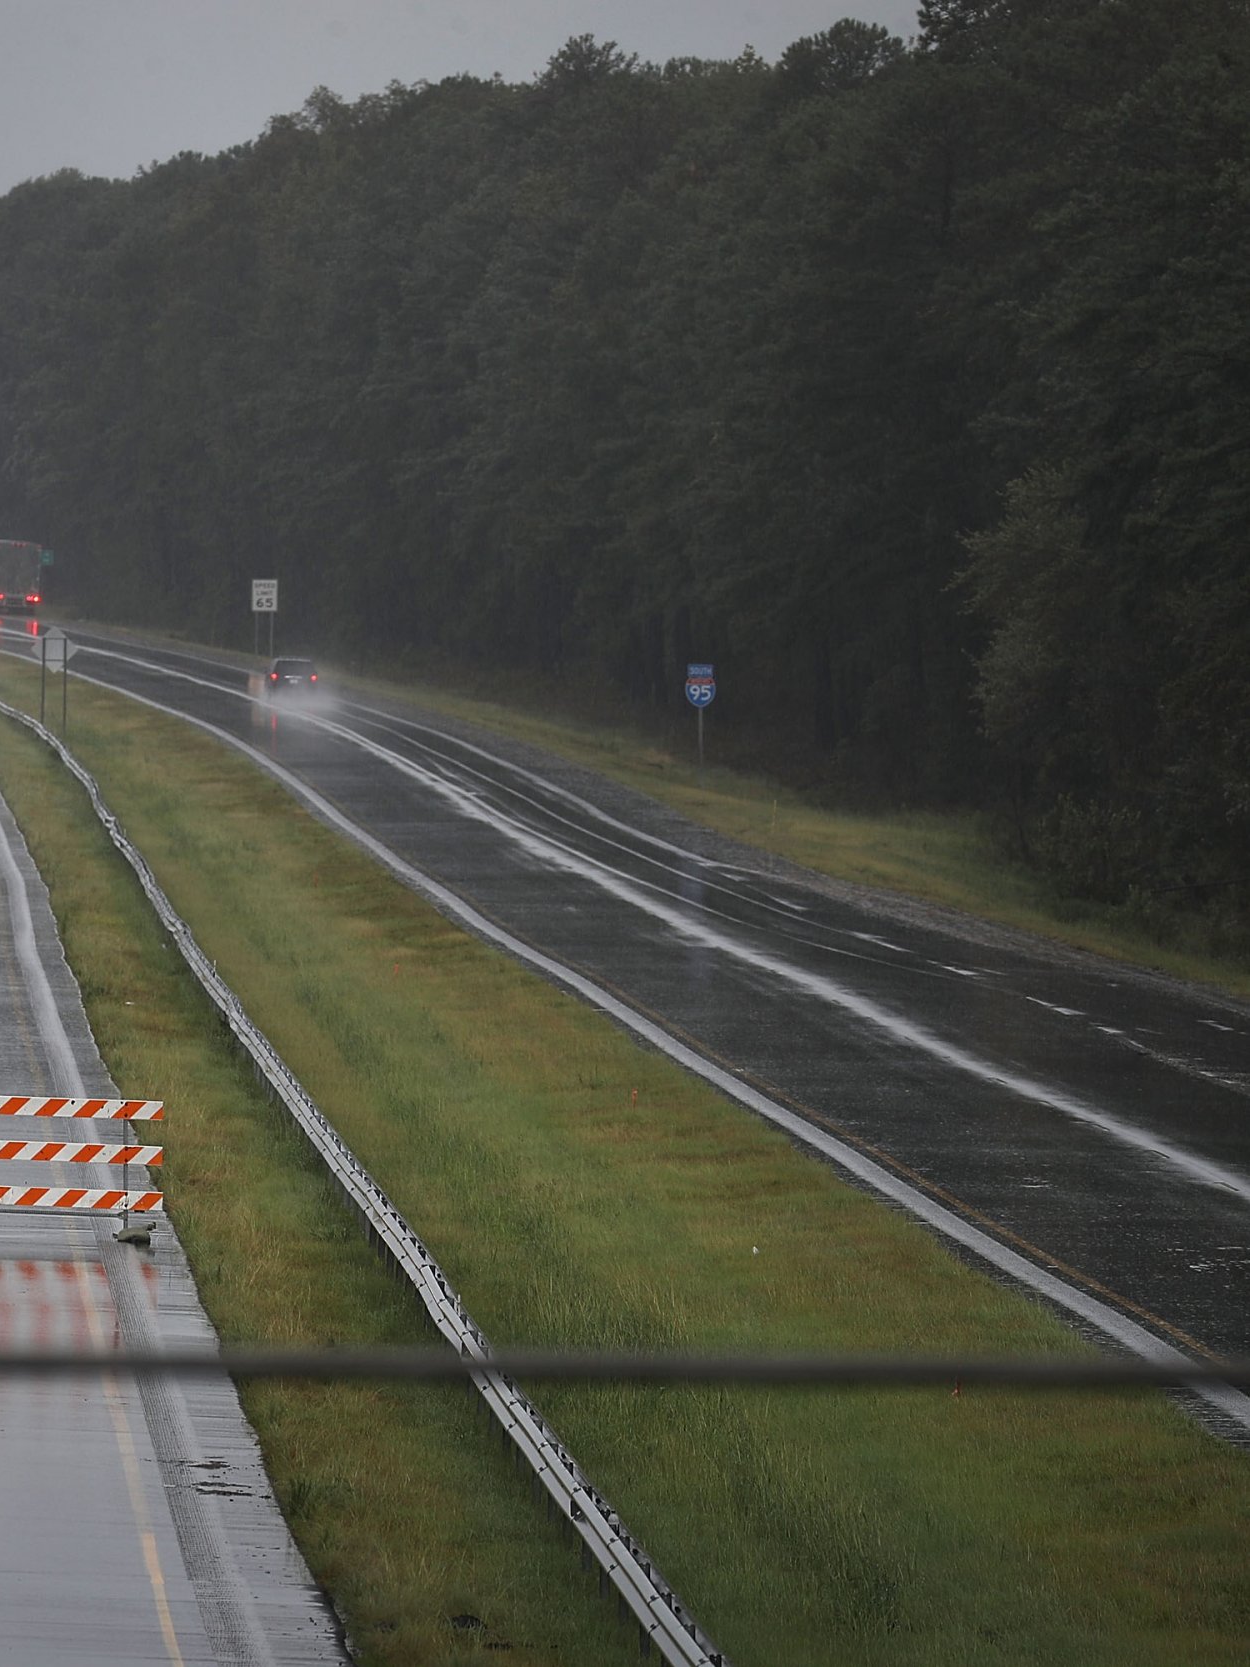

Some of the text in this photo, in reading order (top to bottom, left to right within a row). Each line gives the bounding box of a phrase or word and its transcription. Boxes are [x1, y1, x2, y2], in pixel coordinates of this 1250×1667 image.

[256, 598, 273, 608] 65
[689, 667, 712, 675] SOUTH
[689, 685, 712, 701] 95
